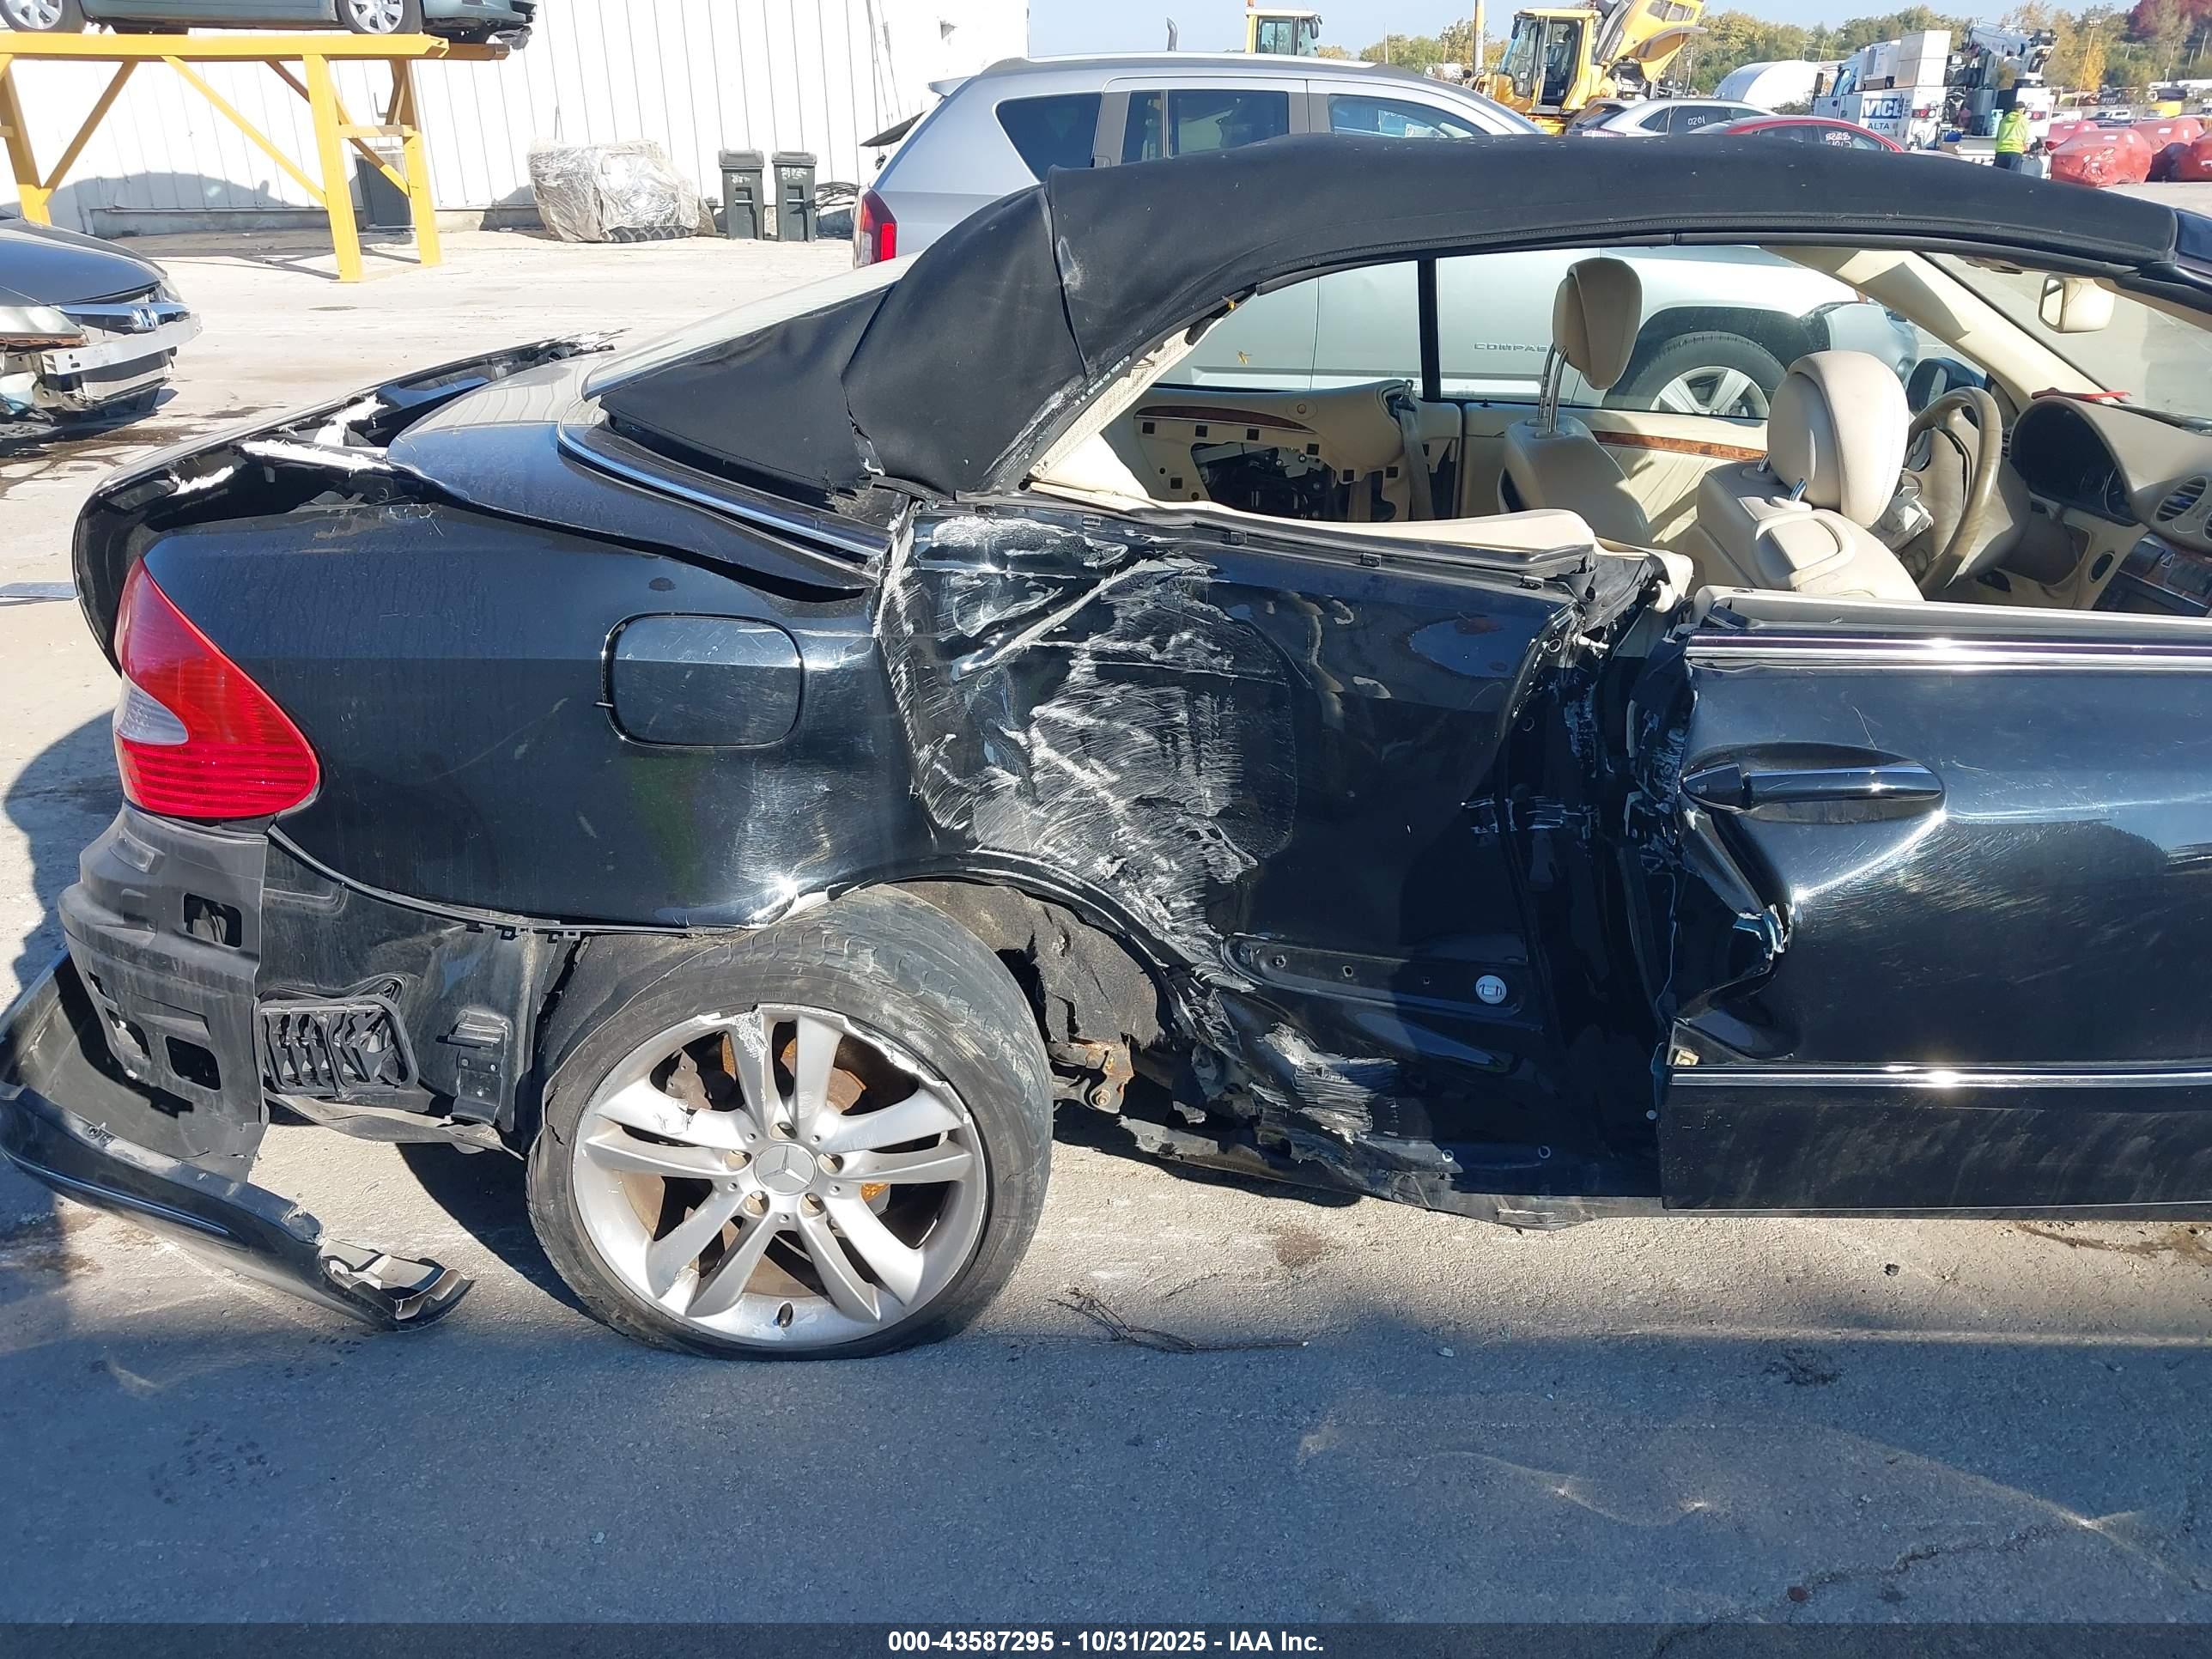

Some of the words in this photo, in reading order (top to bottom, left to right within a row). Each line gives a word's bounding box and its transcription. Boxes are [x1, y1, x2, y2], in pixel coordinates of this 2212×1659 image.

[1687, 115, 1706, 126] 0201
[1868, 122, 1890, 131] ALTA
[1474, 343, 1548, 353] COMPAS
